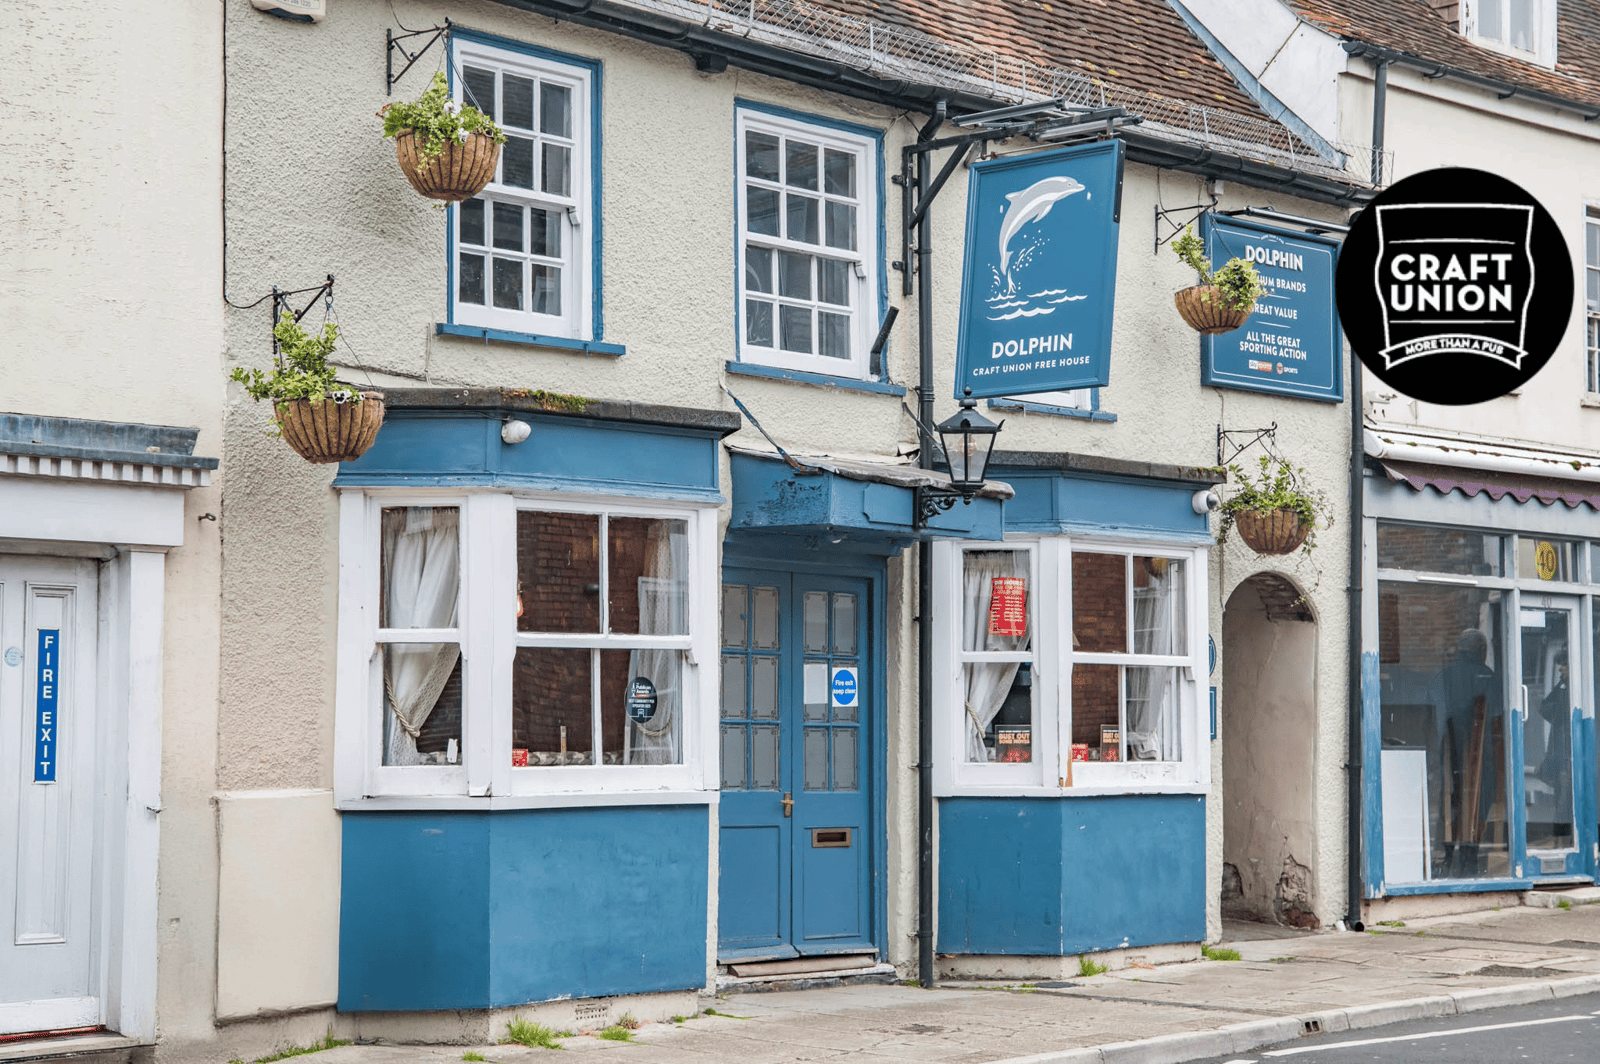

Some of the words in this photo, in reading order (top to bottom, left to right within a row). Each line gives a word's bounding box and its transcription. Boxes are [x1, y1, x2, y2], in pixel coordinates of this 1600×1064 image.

[1245, 245, 1304, 271] DOLPHIN
[1276, 278, 1306, 293] BRANDS
[1274, 305, 1298, 319] VALUE
[991, 333, 1072, 359] DOLPHIN
[1239, 341, 1278, 356] SPORTING
[1278, 347, 1307, 360] ACTION
[1246, 331, 1260, 343] ALL
[1261, 333, 1275, 344] THE
[1276, 335, 1301, 349] GREAT
[973, 366, 1000, 376] CRAFT
[1002, 362, 1032, 373] UNION
[1034, 360, 1056, 369] FREE
[1059, 355, 1090, 366] HOUSE
[42, 635, 55, 699] FIRE
[40, 711, 52, 775] EXIT
